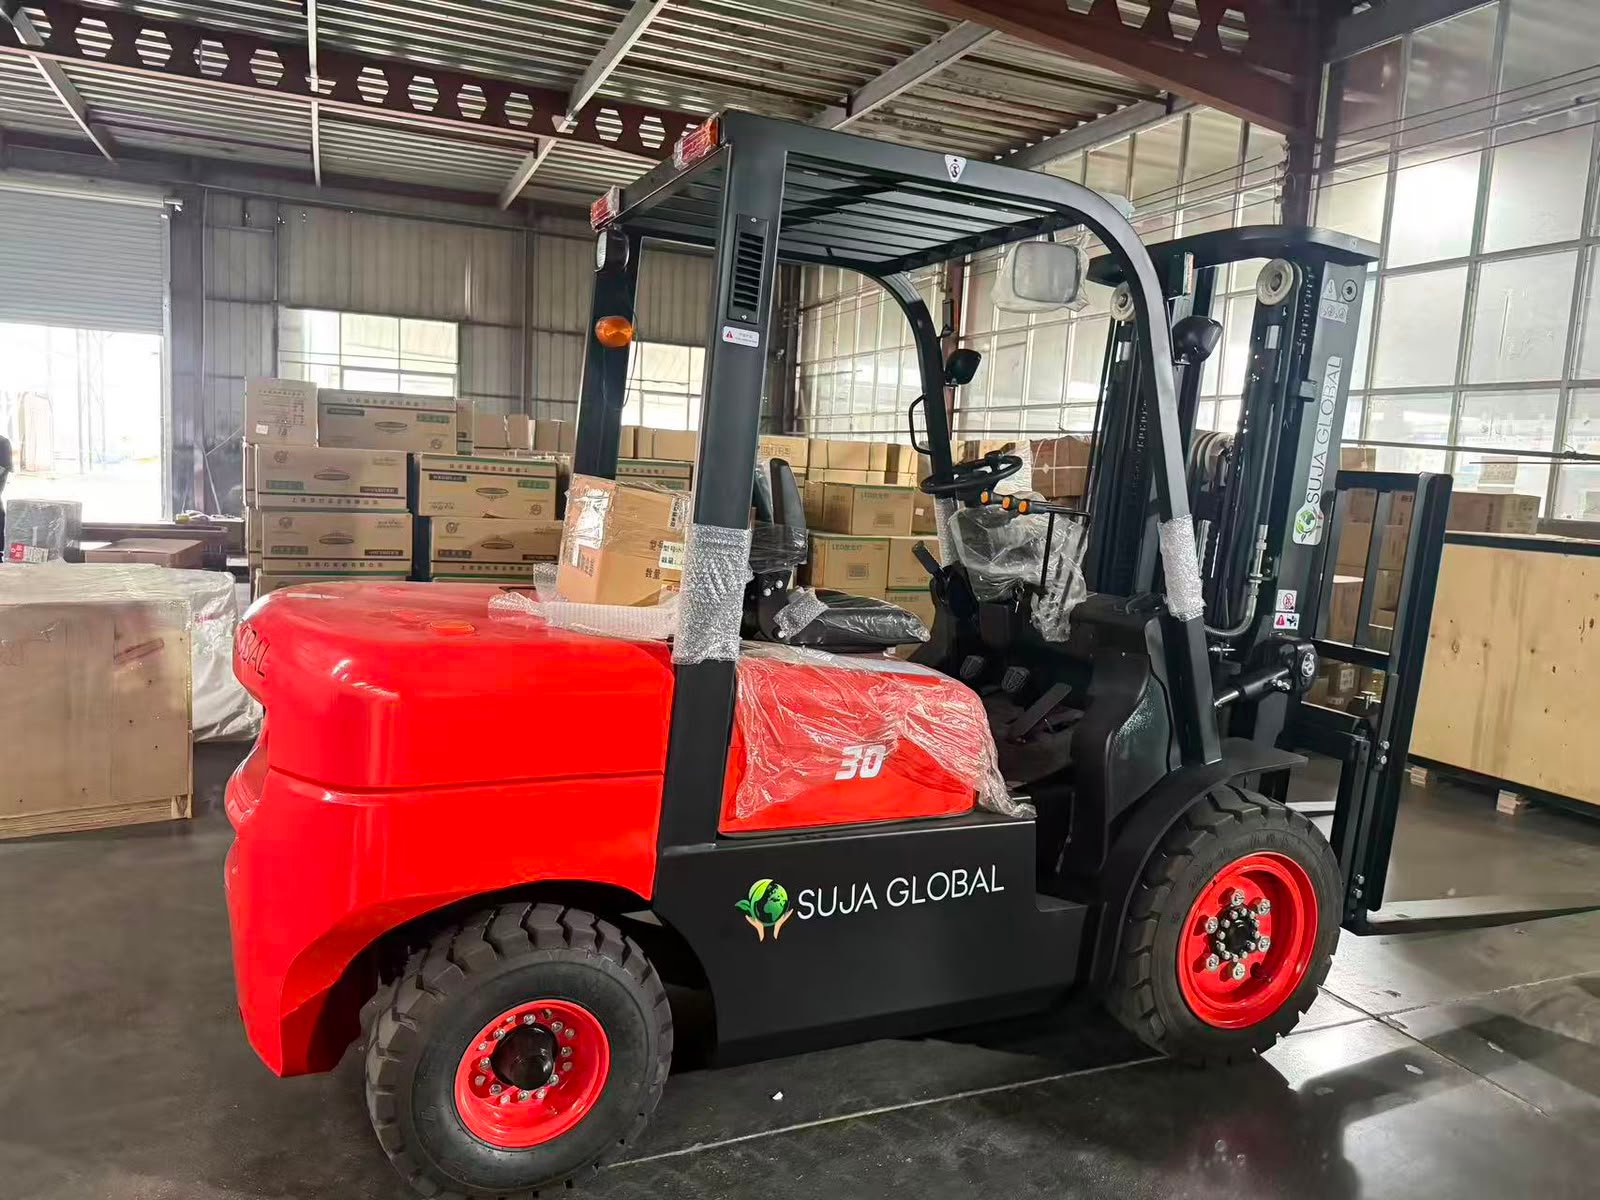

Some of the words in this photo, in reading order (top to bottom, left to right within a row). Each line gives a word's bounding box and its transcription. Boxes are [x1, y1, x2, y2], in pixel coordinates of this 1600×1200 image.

[1316, 357, 1341, 445] GLOBAL
[1306, 451, 1327, 504] SUJA
[834, 744, 886, 780] 30
[796, 882, 878, 920] SUJA
[886, 864, 1005, 907] GLOBAL
